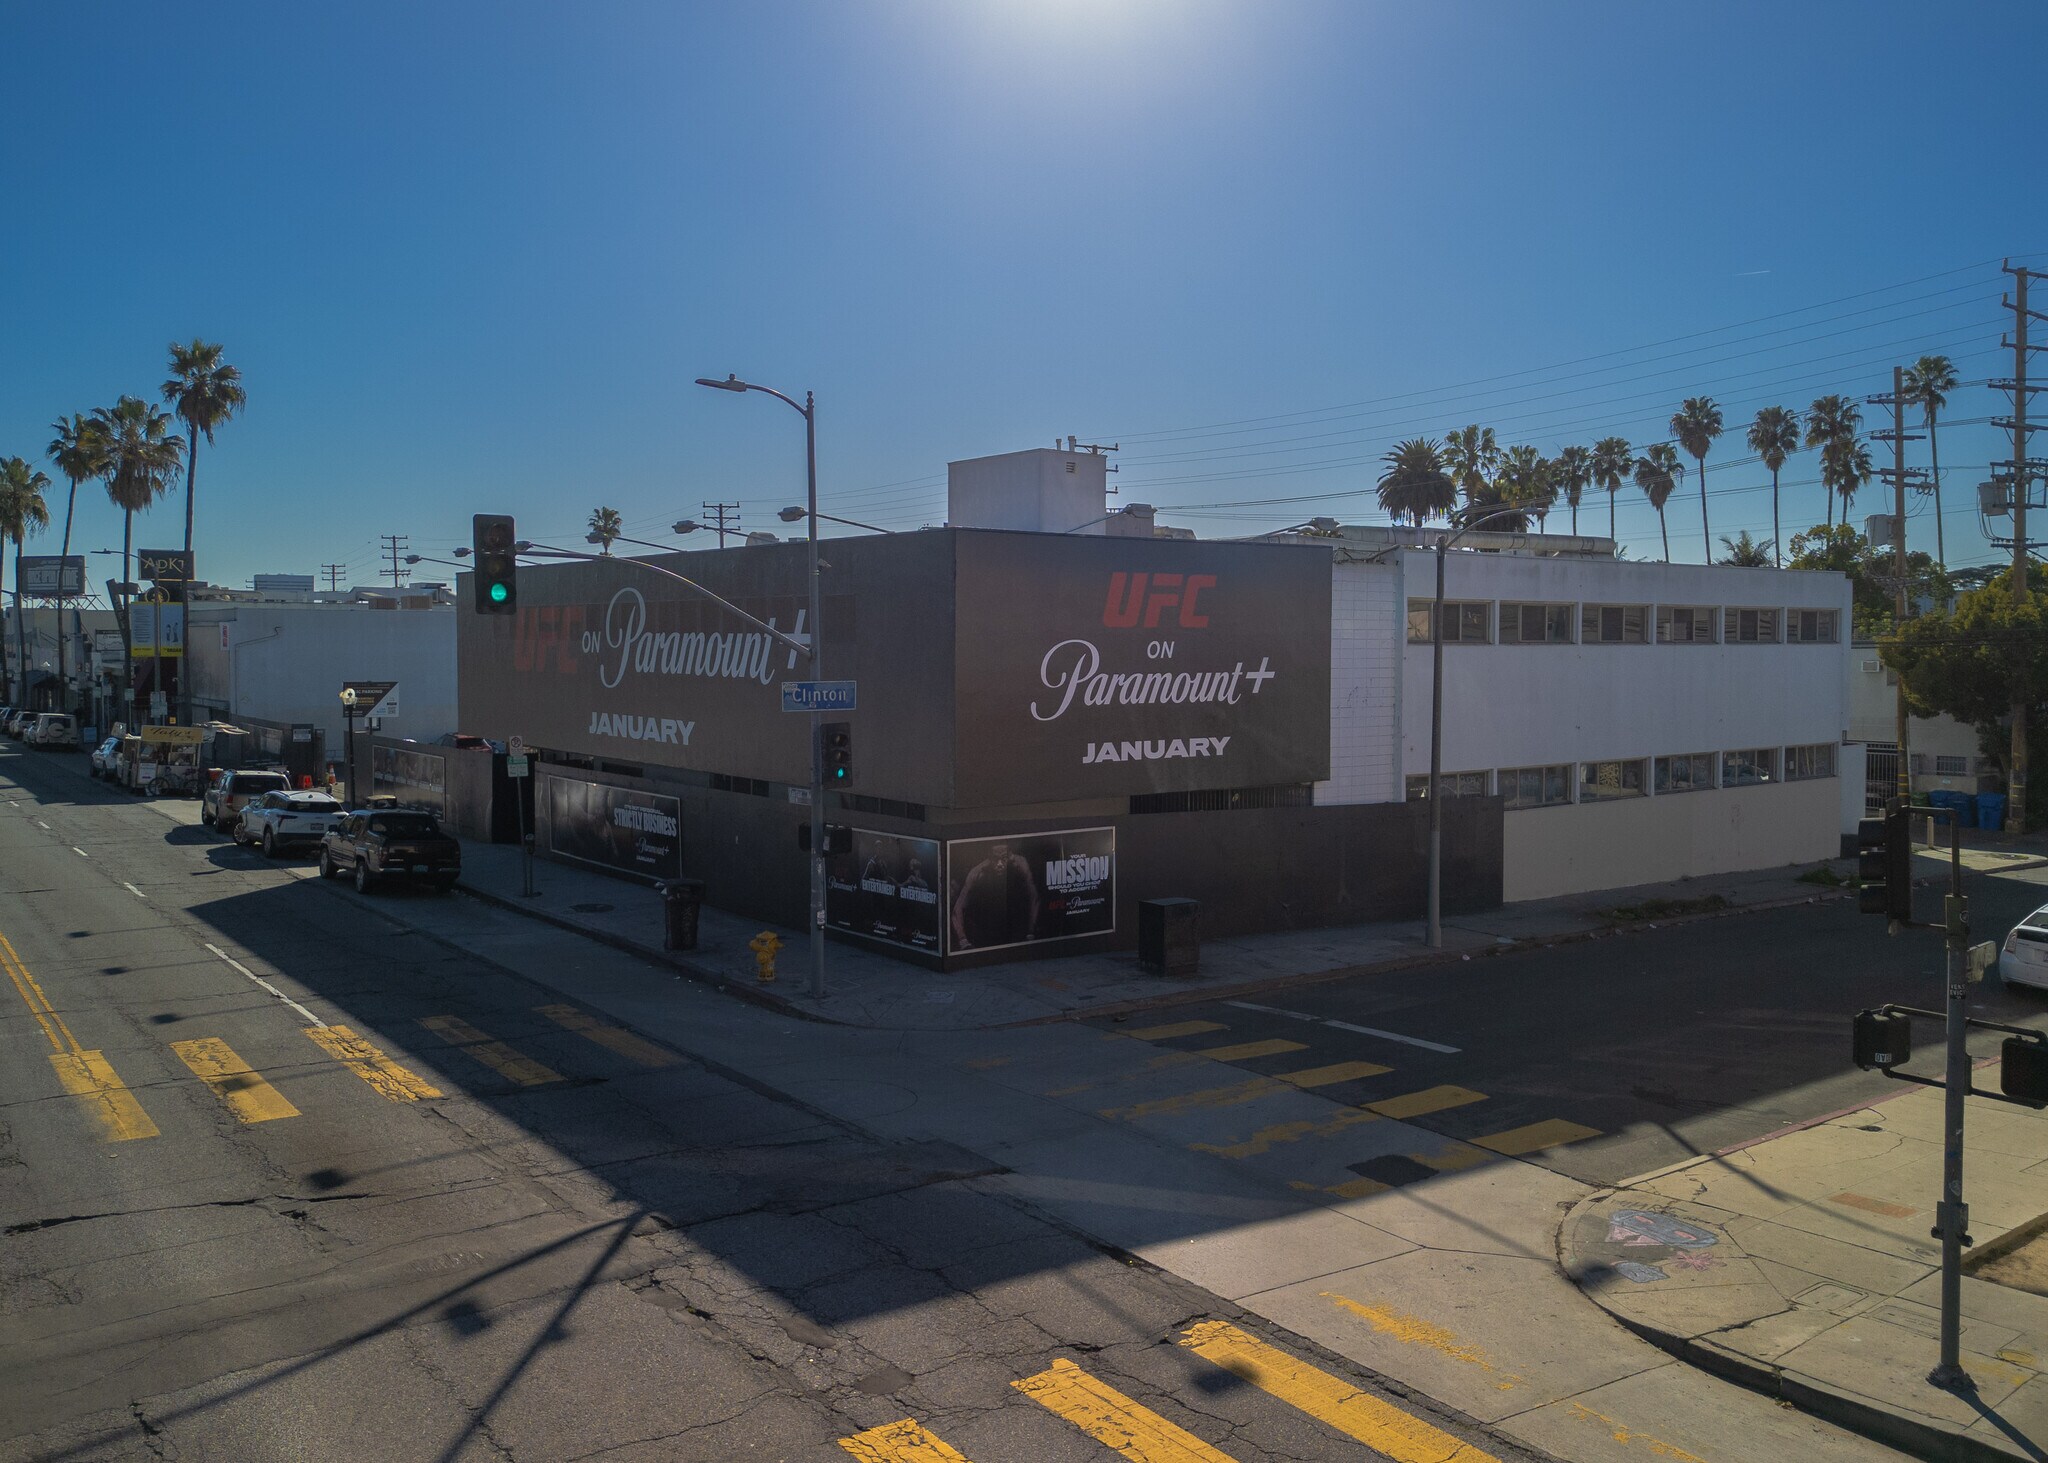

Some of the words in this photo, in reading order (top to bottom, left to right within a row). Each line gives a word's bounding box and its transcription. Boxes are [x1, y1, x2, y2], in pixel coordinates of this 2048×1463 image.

[1103, 571, 1218, 628] UFC
[514, 606, 586, 674] UFC
[582, 630, 602, 654] ON
[1146, 640, 1175, 660] ON
[1030, 638, 1276, 721] Paramount+
[792, 688, 846, 703] Clinton
[589, 711, 695, 746] JANUARY
[1082, 736, 1231, 765] JANUARY
[614, 807, 643, 831] STRICTLY
[643, 812, 677, 837] BUSINESS
[1046, 855, 1109, 886] MISSION
